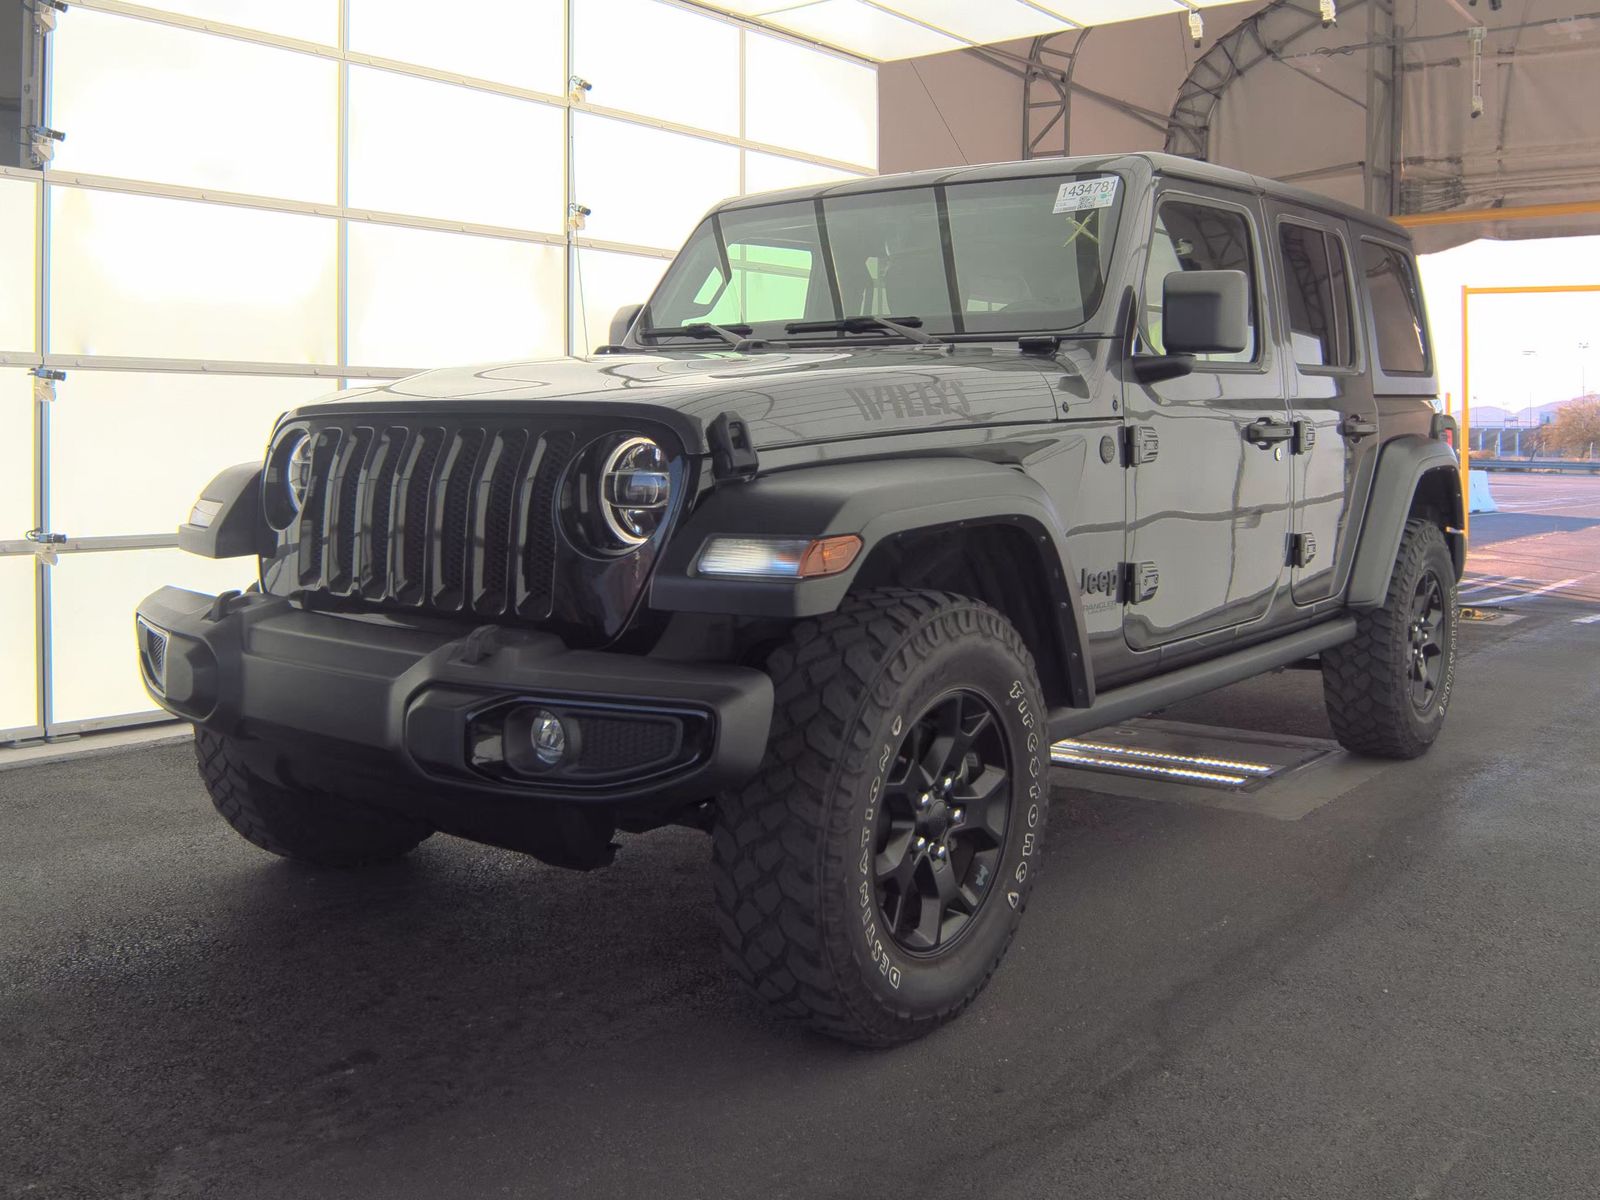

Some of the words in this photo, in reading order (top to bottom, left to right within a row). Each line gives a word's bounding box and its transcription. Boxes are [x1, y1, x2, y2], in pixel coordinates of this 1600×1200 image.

[1062, 180, 1117, 198] 1434781
[844, 380, 971, 421] WILLYS
[1080, 568, 1117, 596] Jeep
[1008, 680, 1042, 883] Firestone
[859, 744, 901, 989] DESTINATION
